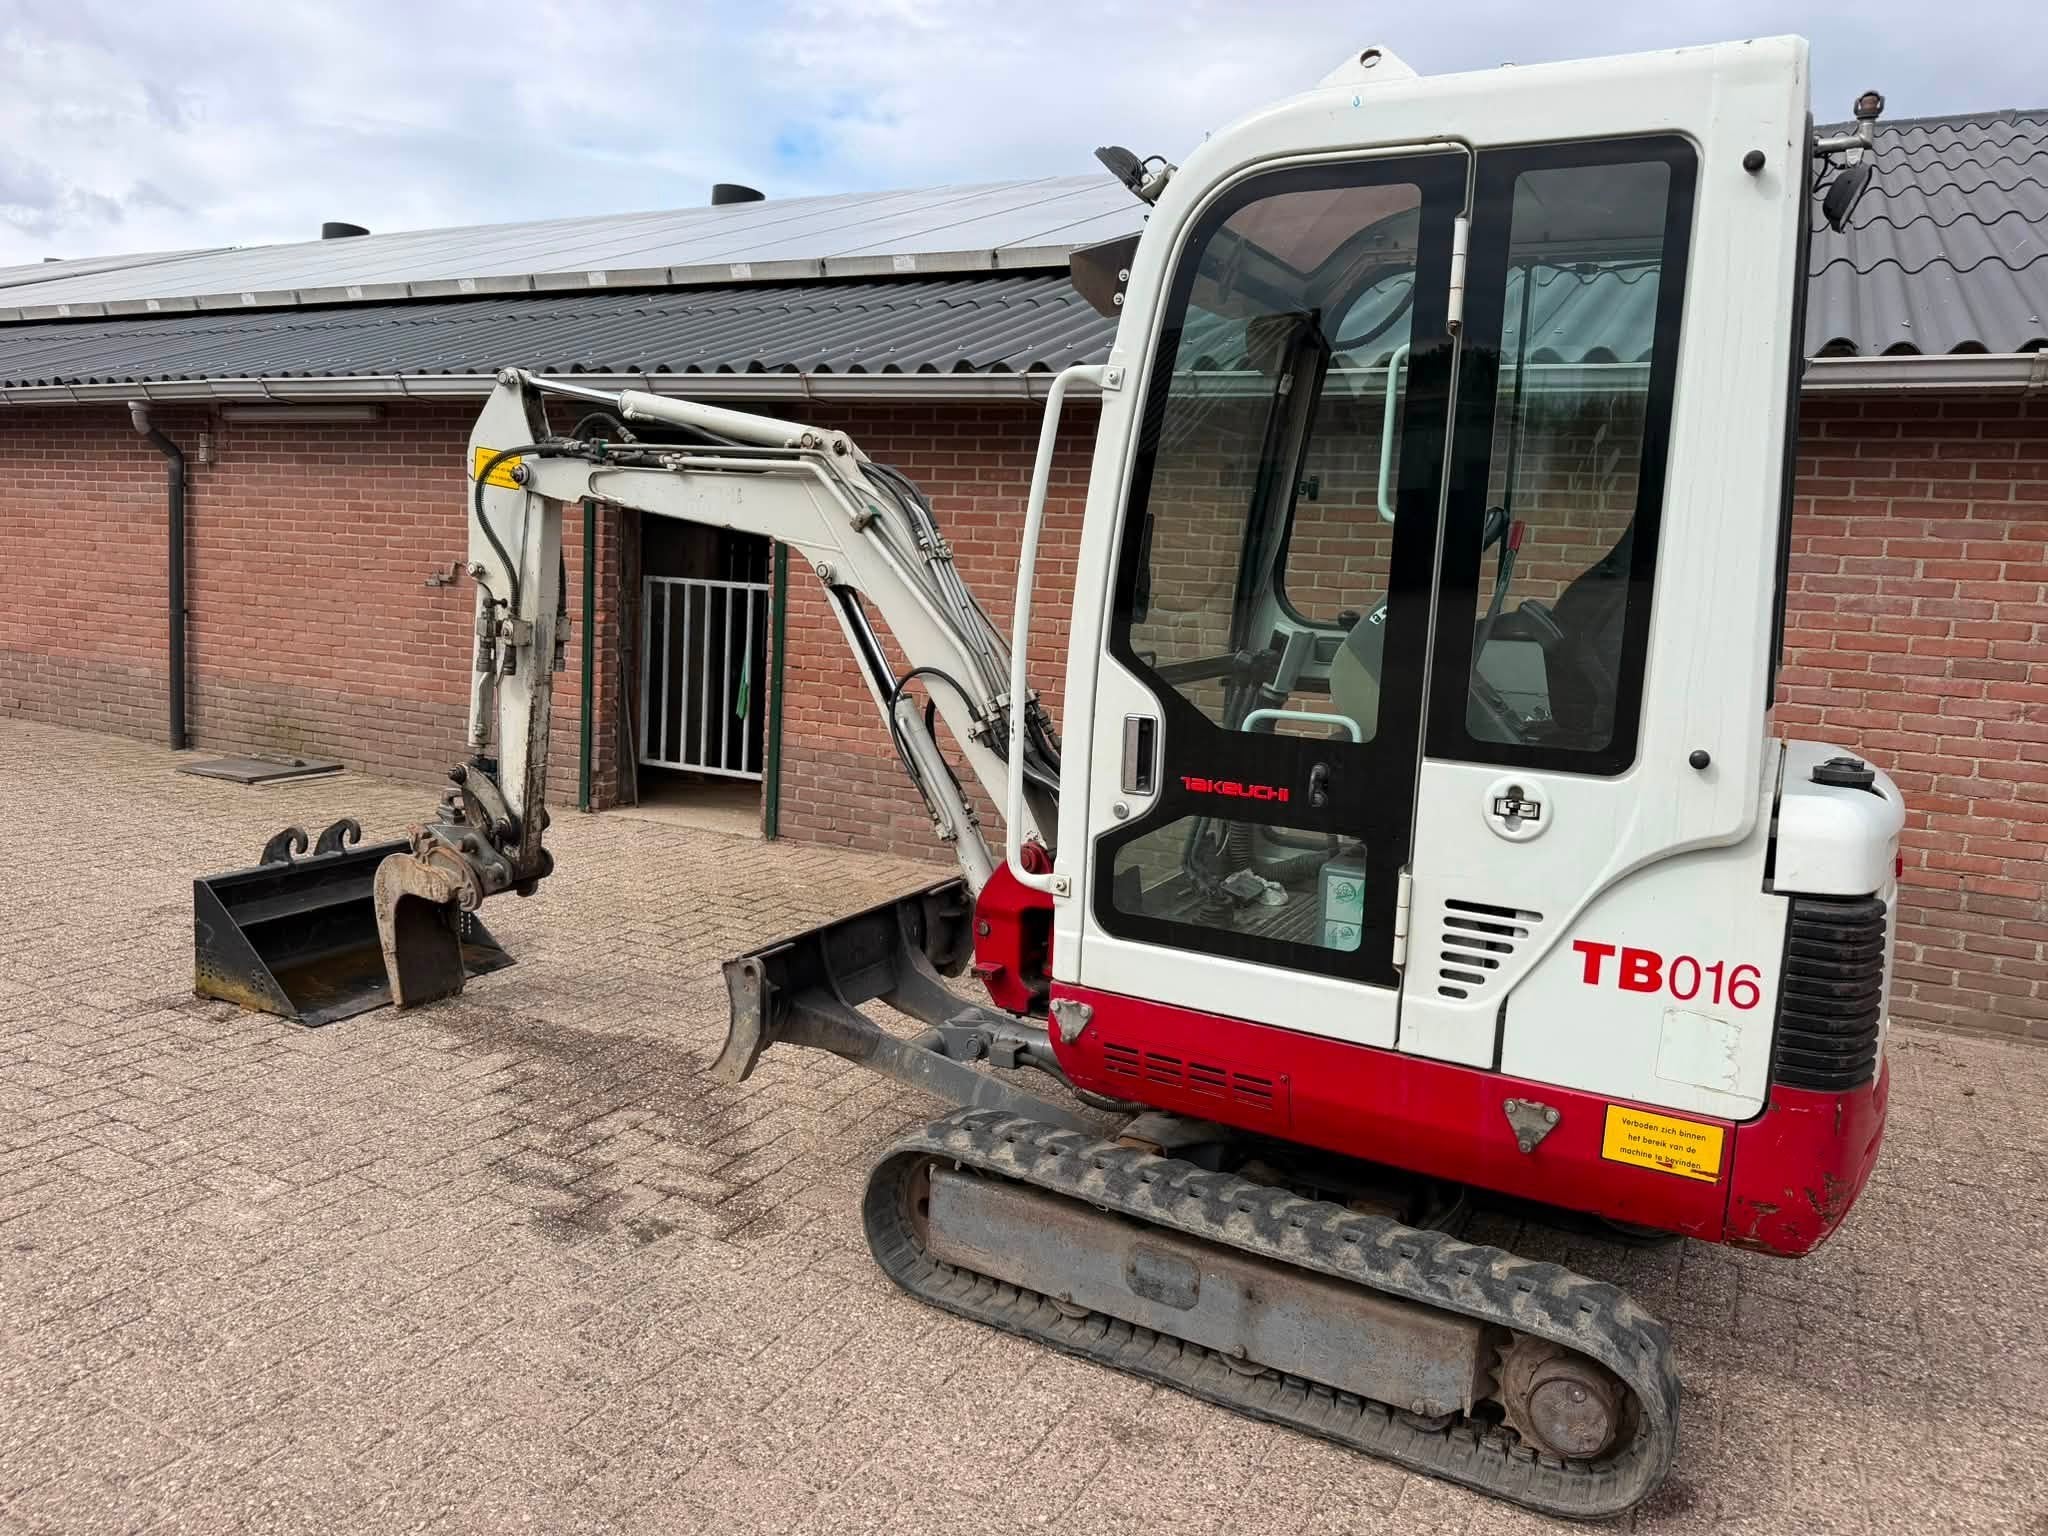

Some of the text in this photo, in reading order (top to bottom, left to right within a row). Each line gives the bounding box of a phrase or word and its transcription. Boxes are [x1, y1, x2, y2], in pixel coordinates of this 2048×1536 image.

[1573, 939, 1761, 1010] TB016
[1622, 1117, 1706, 1142] Verboden zich binnen
[1628, 1133, 1696, 1154] het bereik van de
[1620, 1146, 1701, 1169] machine te bevinden
